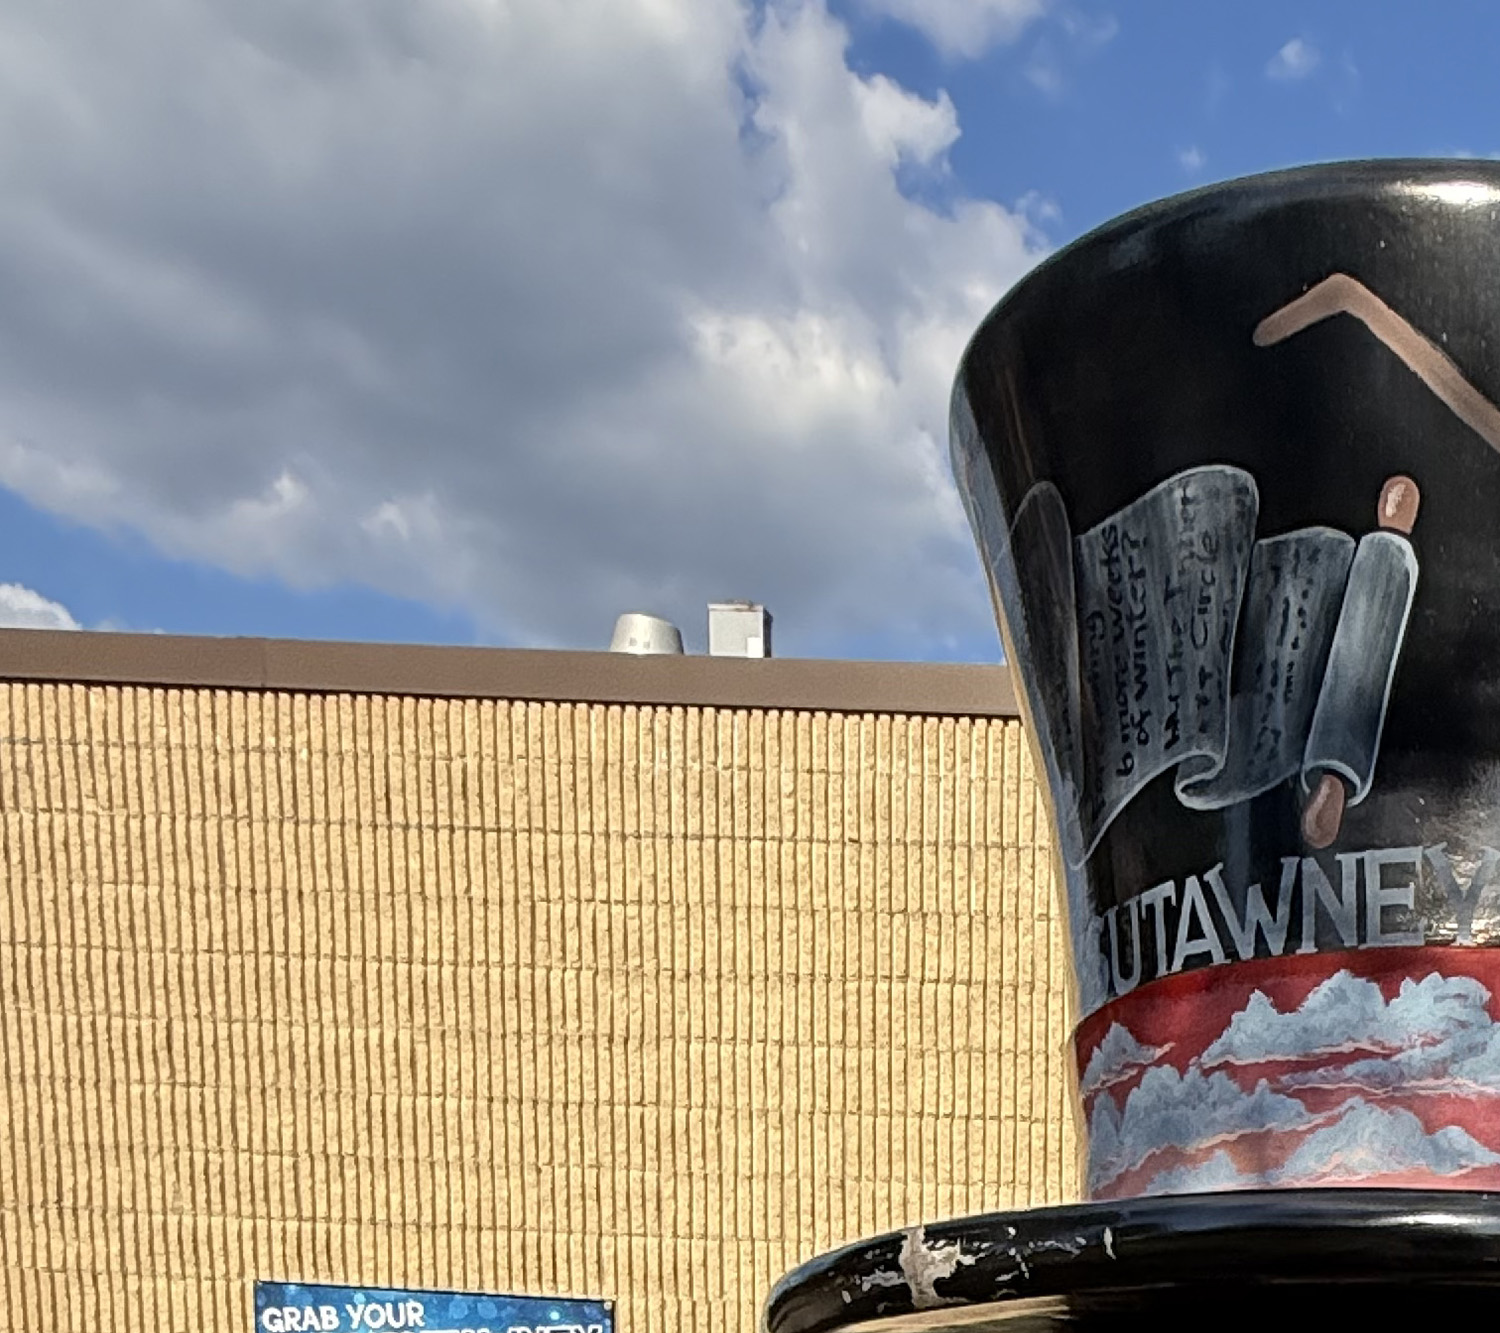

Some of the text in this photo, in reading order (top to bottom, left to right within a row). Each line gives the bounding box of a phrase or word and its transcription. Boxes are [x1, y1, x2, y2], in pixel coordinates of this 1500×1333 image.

[1099, 522, 1124, 643] weeks
[1122, 530, 1152, 747] of winter?
[1190, 530, 1221, 650] Circle
[1115, 752, 1135, 776] 6
[262, 1302, 425, 1332] GRAB YOUR
